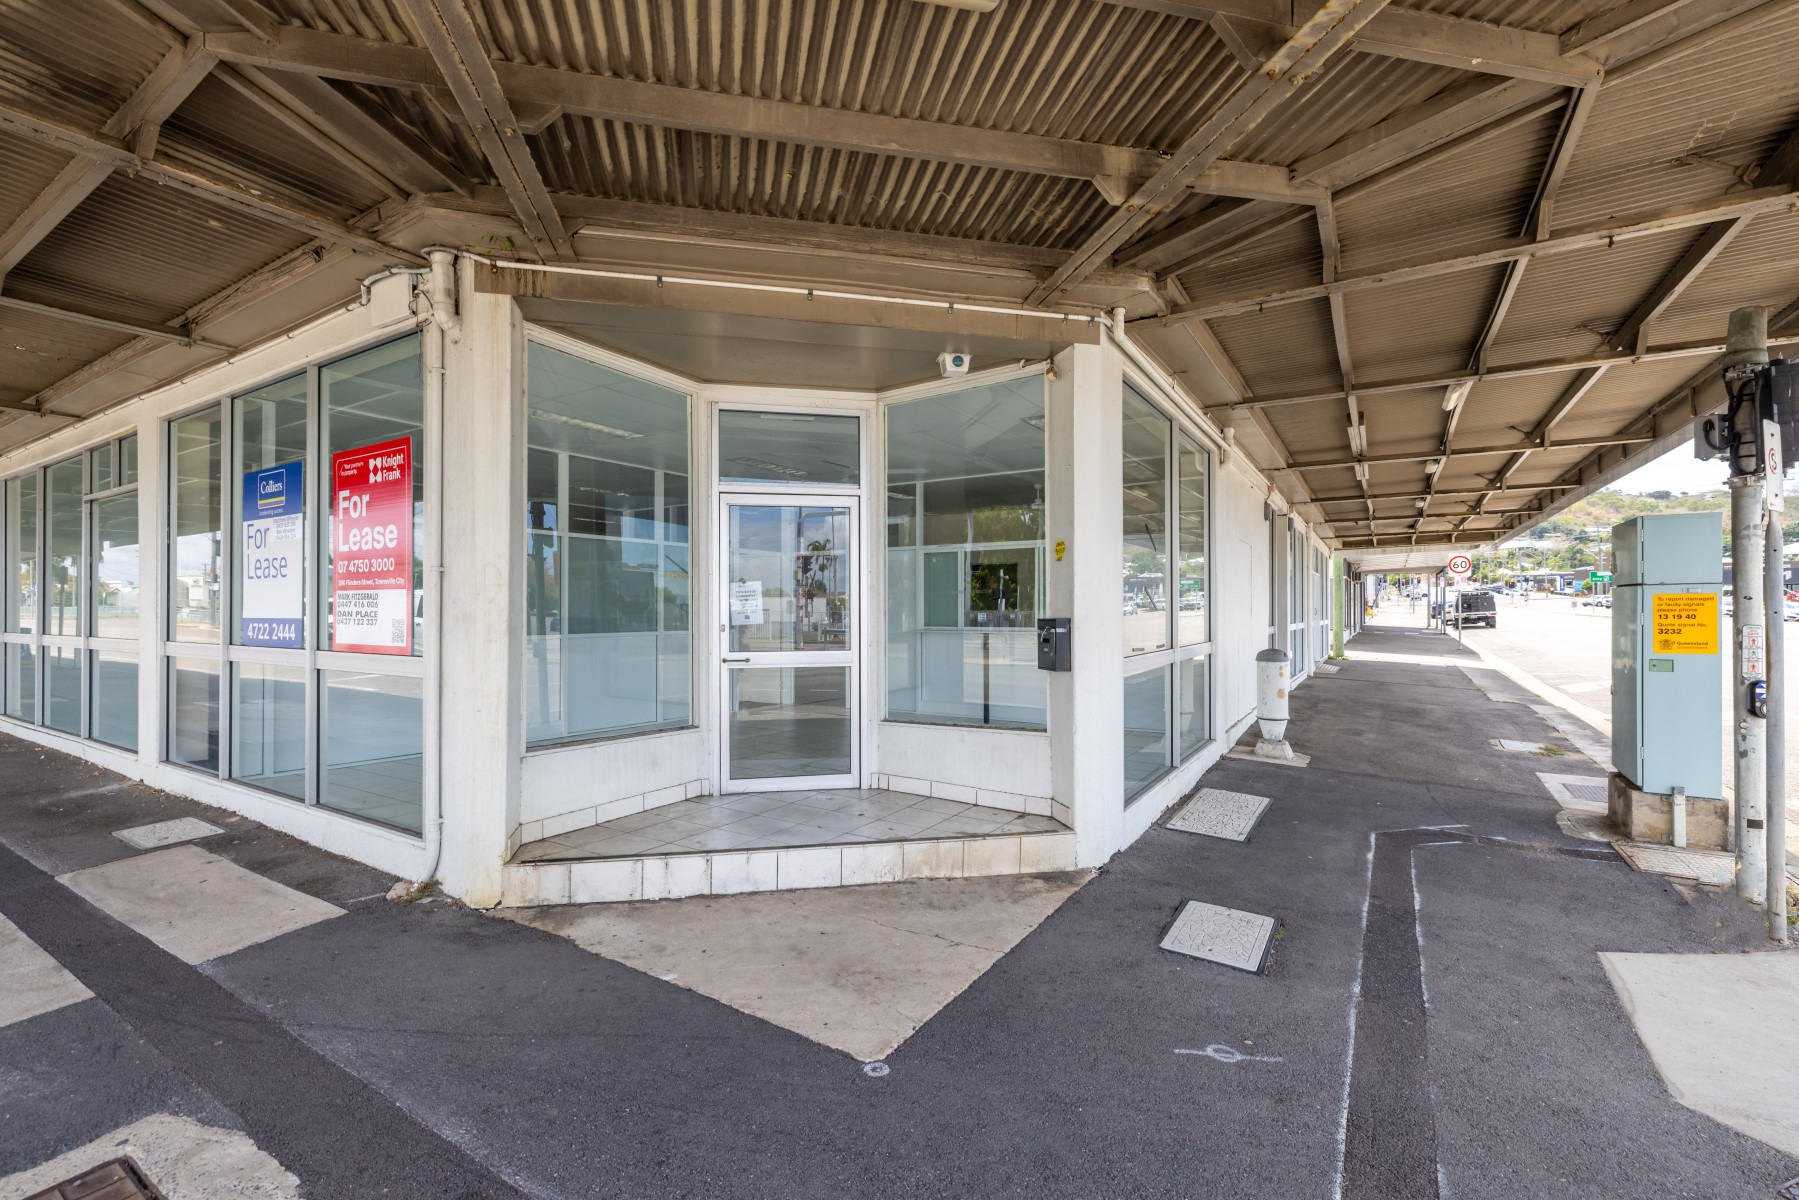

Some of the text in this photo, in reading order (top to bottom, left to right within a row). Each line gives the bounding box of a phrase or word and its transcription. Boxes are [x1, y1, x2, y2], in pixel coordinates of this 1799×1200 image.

[383, 453, 404, 468] Knight
[383, 468, 400, 481] Frank
[261, 480, 282, 494] Colliers
[339, 490, 369, 520] For
[247, 524, 269, 549] For
[339, 524, 398, 552] Lease
[248, 554, 287, 579] Lease
[338, 558, 394, 573] 07 4750 3000
[1452, 560, 1467, 568] 60
[247, 623, 295, 640] 4722 2444
